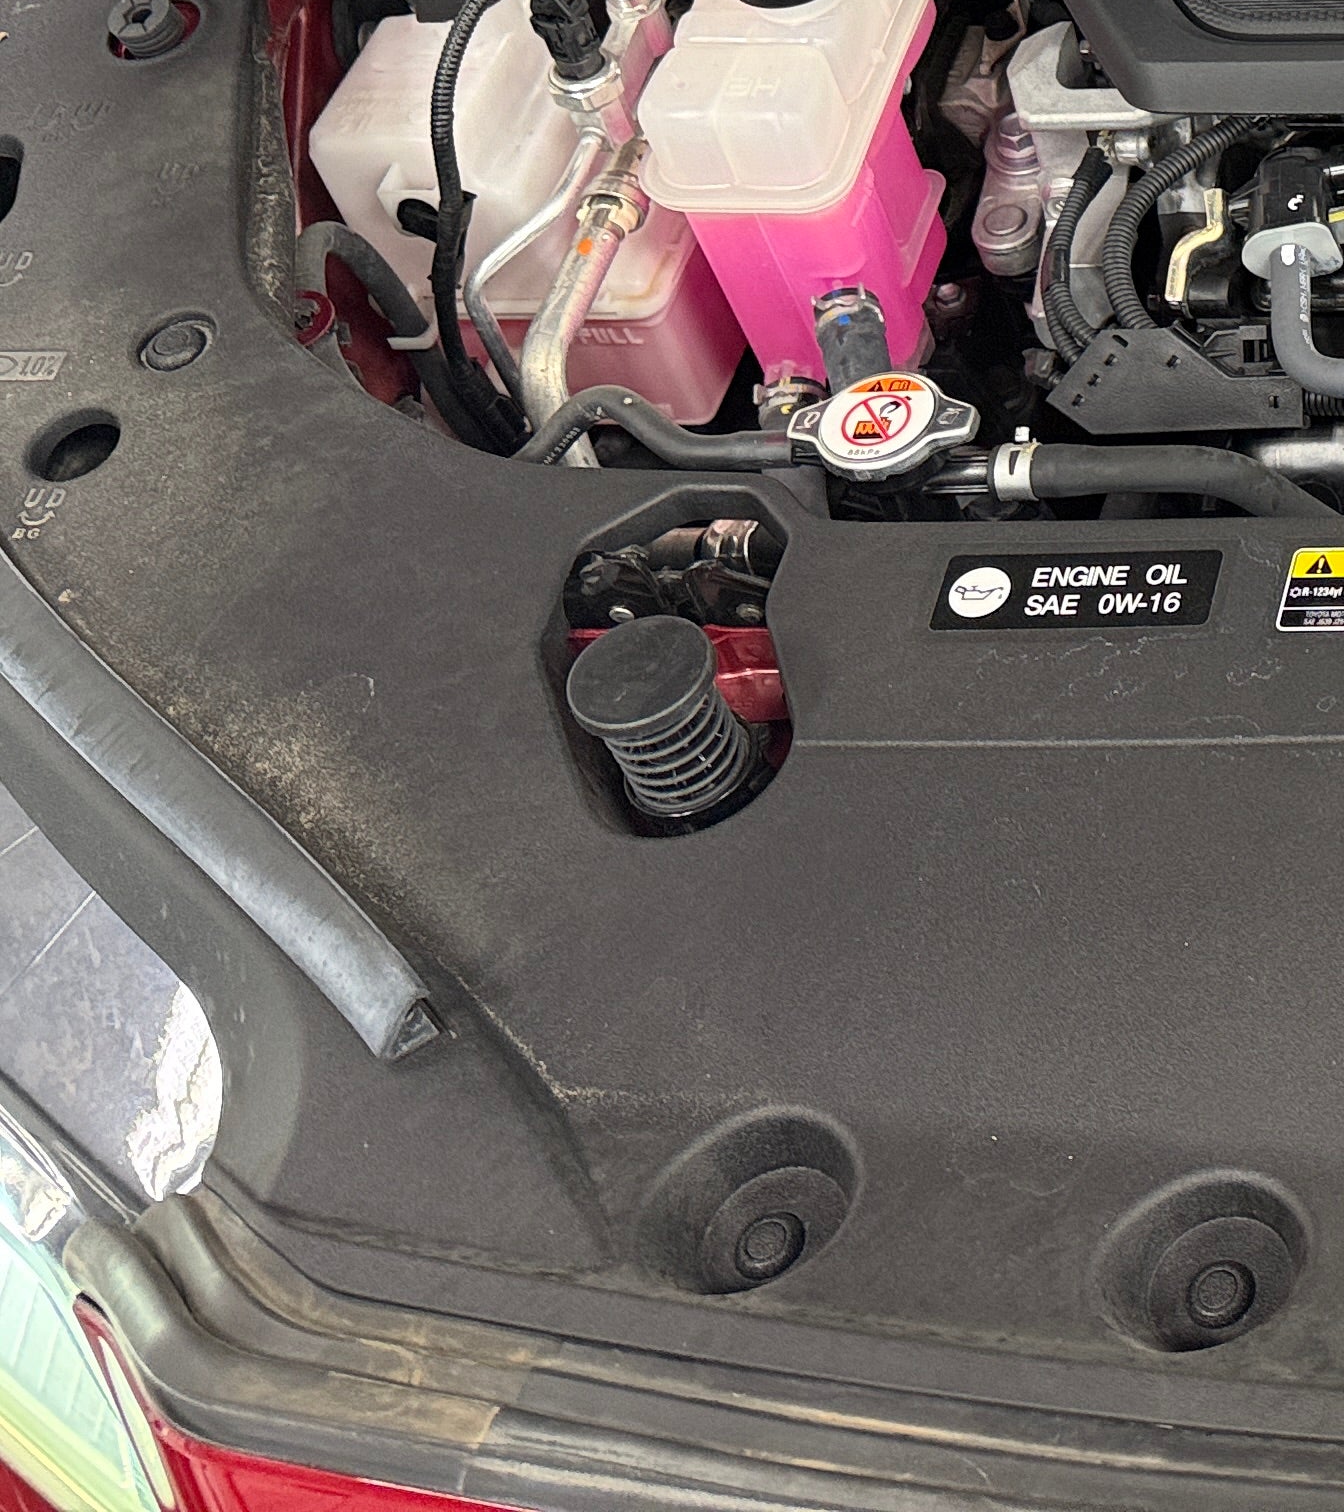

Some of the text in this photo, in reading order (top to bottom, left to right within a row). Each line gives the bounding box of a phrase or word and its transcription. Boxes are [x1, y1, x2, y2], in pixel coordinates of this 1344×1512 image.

[24, 488, 67, 508] UD
[11, 527, 41, 539] BG
[1030, 564, 1188, 588] ENGINE OIL
[1023, 591, 1183, 617] SAE 0W-16
